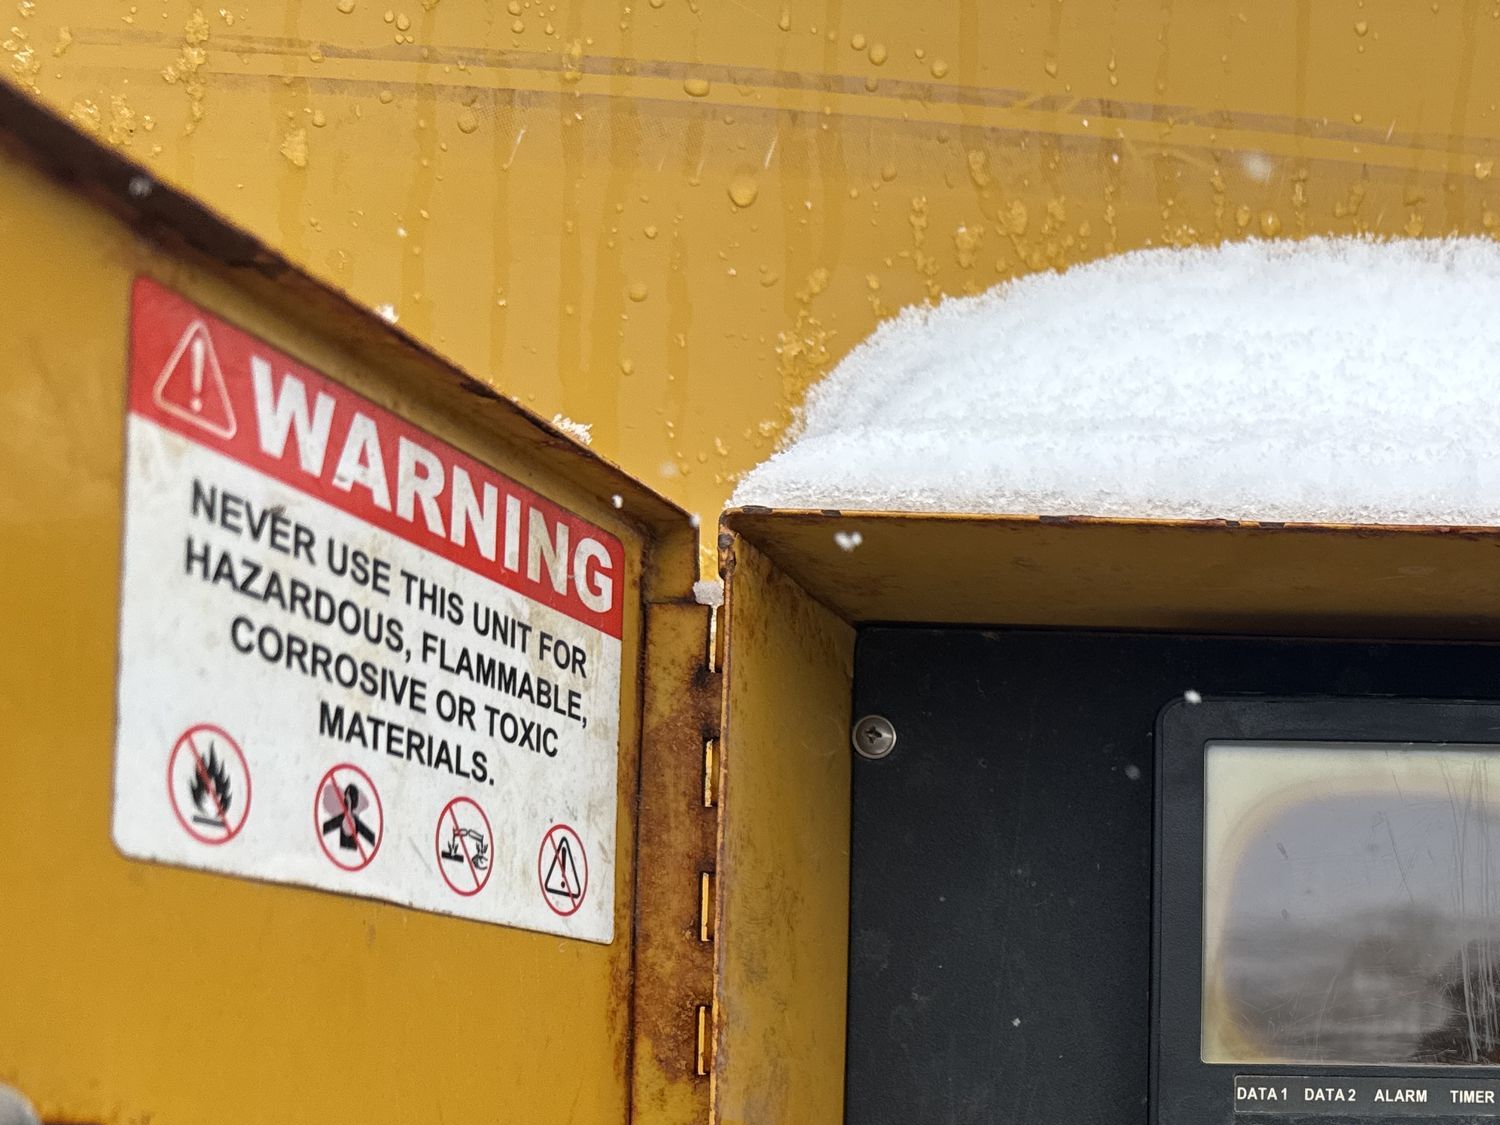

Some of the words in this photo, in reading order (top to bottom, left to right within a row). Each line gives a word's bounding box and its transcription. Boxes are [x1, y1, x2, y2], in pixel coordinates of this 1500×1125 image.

[249, 354, 614, 614] WARNING
[191, 479, 314, 564] NEVER
[326, 539, 391, 597] USE
[400, 568, 465, 626] THIS
[473, 601, 531, 654] UNIT
[538, 630, 588, 678] FOR
[184, 537, 413, 663] HAZARDOUS,
[421, 632, 589, 728] FLAMMABLE,
[230, 615, 428, 713] CORROSIVE
[435, 687, 477, 727] OR
[485, 704, 559, 758] TOXIC
[318, 701, 496, 786] MATERIALS.
[1237, 1086, 1278, 1101] DATA
[1280, 1087, 1287, 1101] 1
[1304, 1087, 1346, 1102] DATA
[1347, 1088, 1356, 1102] 2
[1374, 1088, 1428, 1103] ALARM
[1449, 1090, 1495, 1104] TIMER
